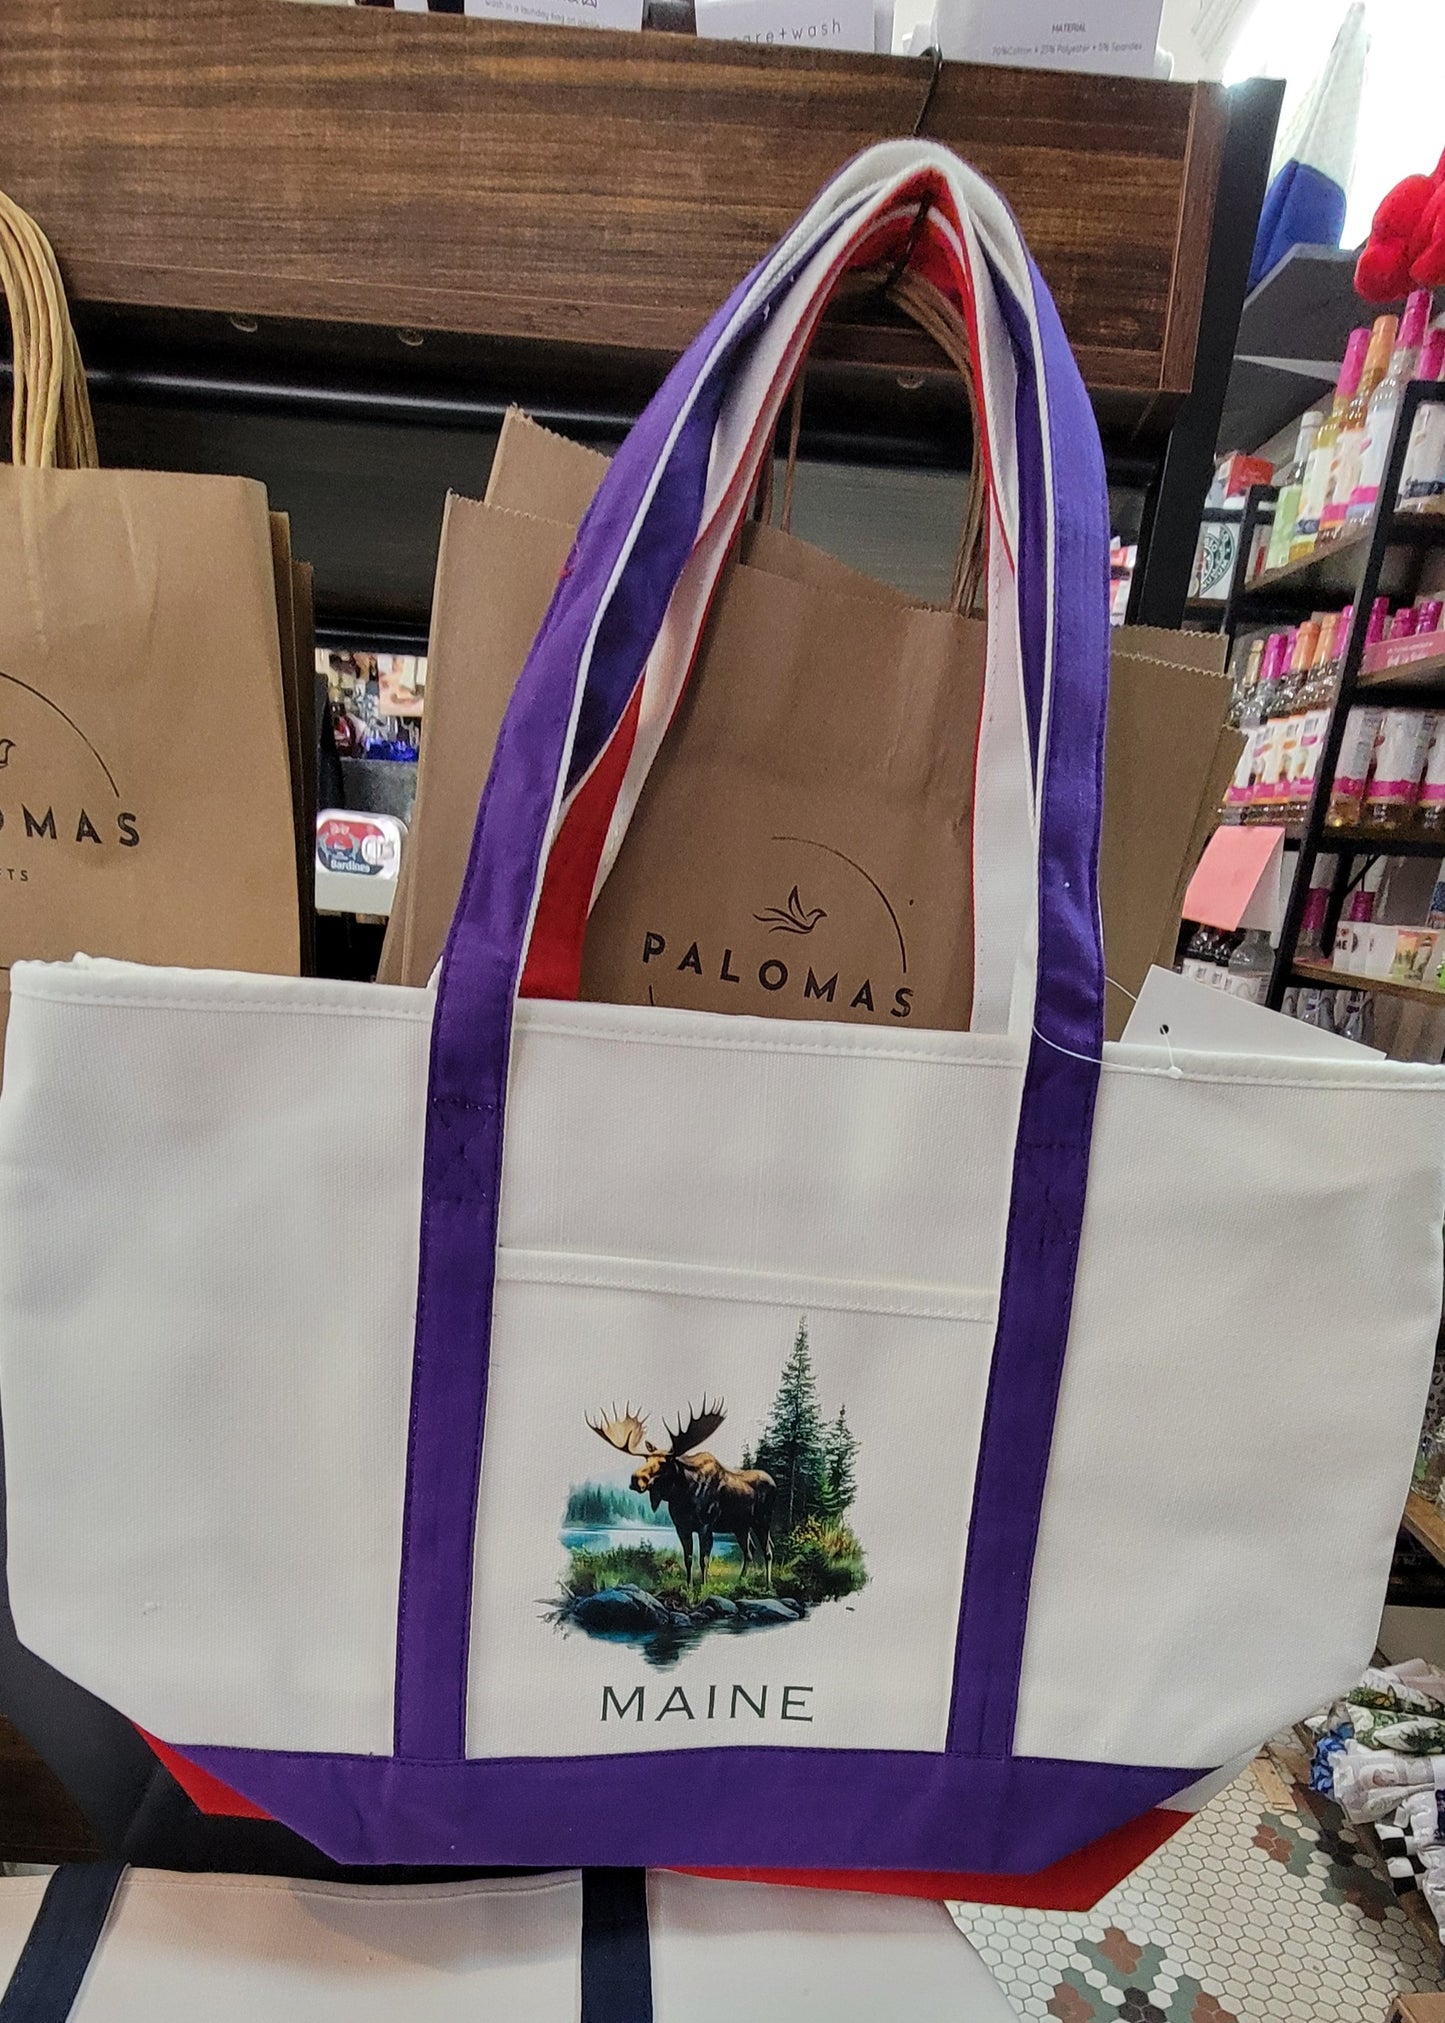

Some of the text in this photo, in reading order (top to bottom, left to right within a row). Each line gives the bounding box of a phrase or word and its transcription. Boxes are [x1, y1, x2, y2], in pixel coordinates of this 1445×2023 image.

[1052, 23, 1086, 33] MATERIAL
[0, 803, 140, 847] MAS
[643, 931, 914, 1017] PALOMAS
[600, 1685, 814, 1722] MAINE
